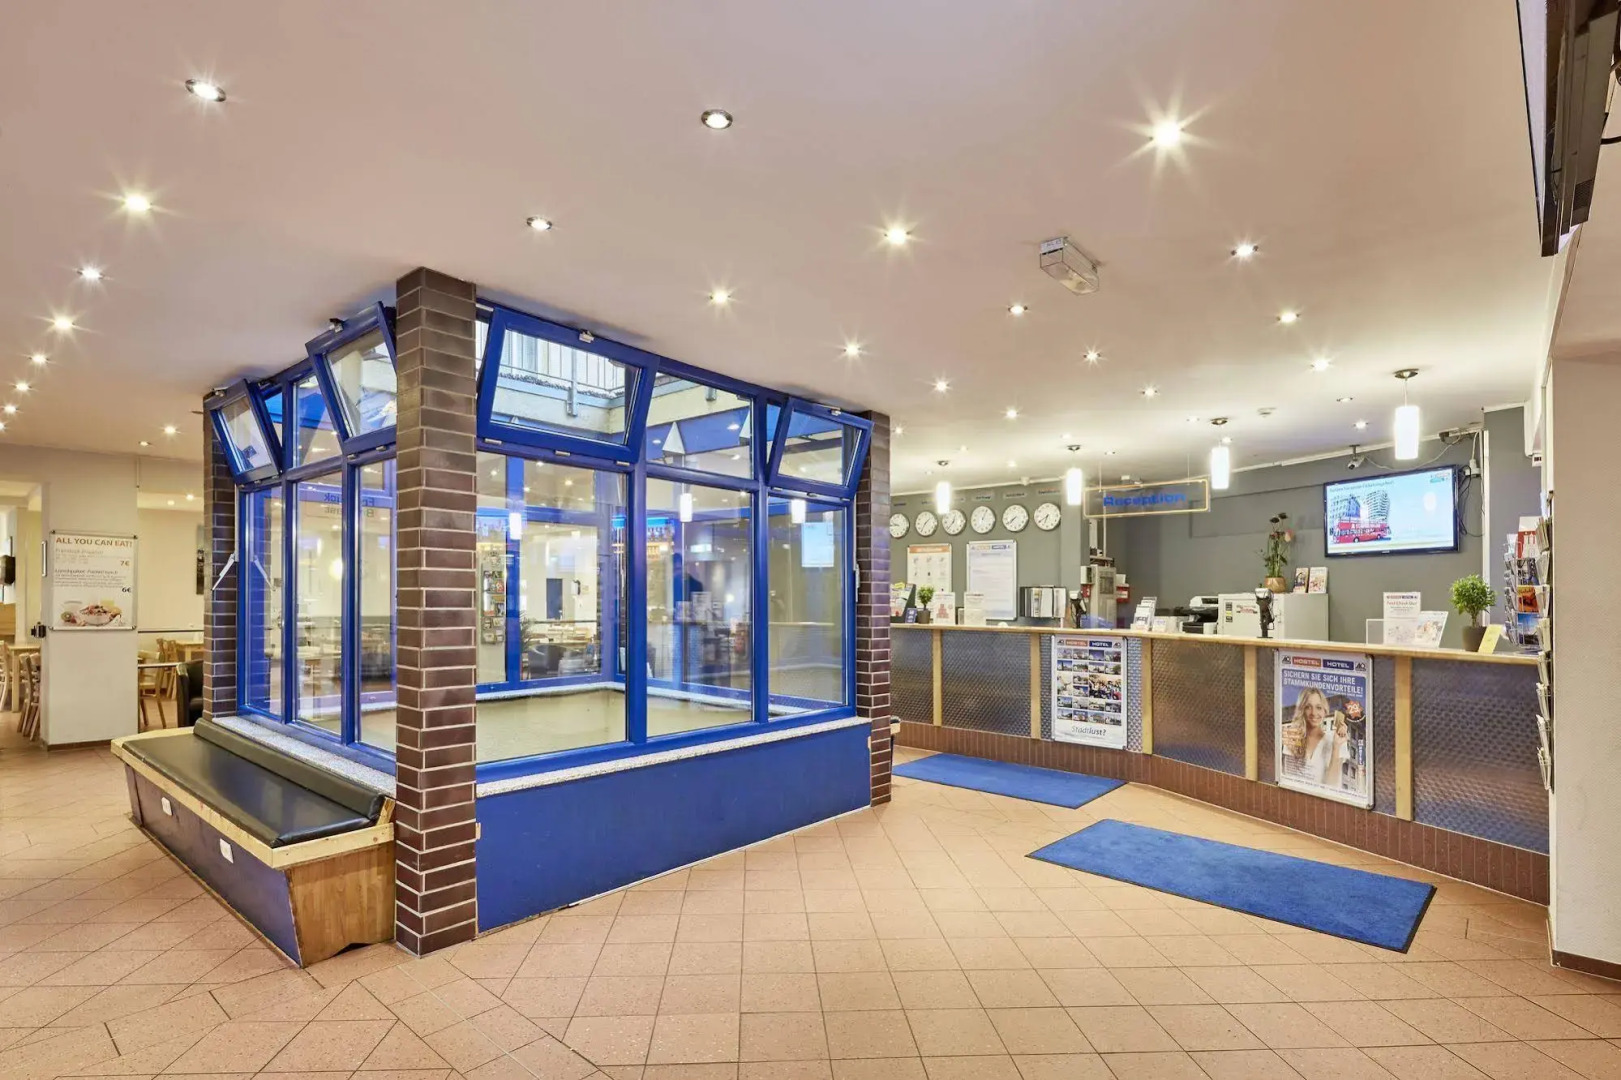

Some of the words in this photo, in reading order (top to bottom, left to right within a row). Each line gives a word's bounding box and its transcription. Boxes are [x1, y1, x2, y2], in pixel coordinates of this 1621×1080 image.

[1103, 492, 1186, 506] Reception
[74, 538, 93, 546] YOU
[94, 539, 113, 547] CAN
[114, 540, 133, 548] EAT!
[1283, 670, 1309, 678] SICHERN
[1340, 676, 1355, 684] IHRE
[1283, 677, 1363, 695] STAMMKUNDENVORTEILE!
